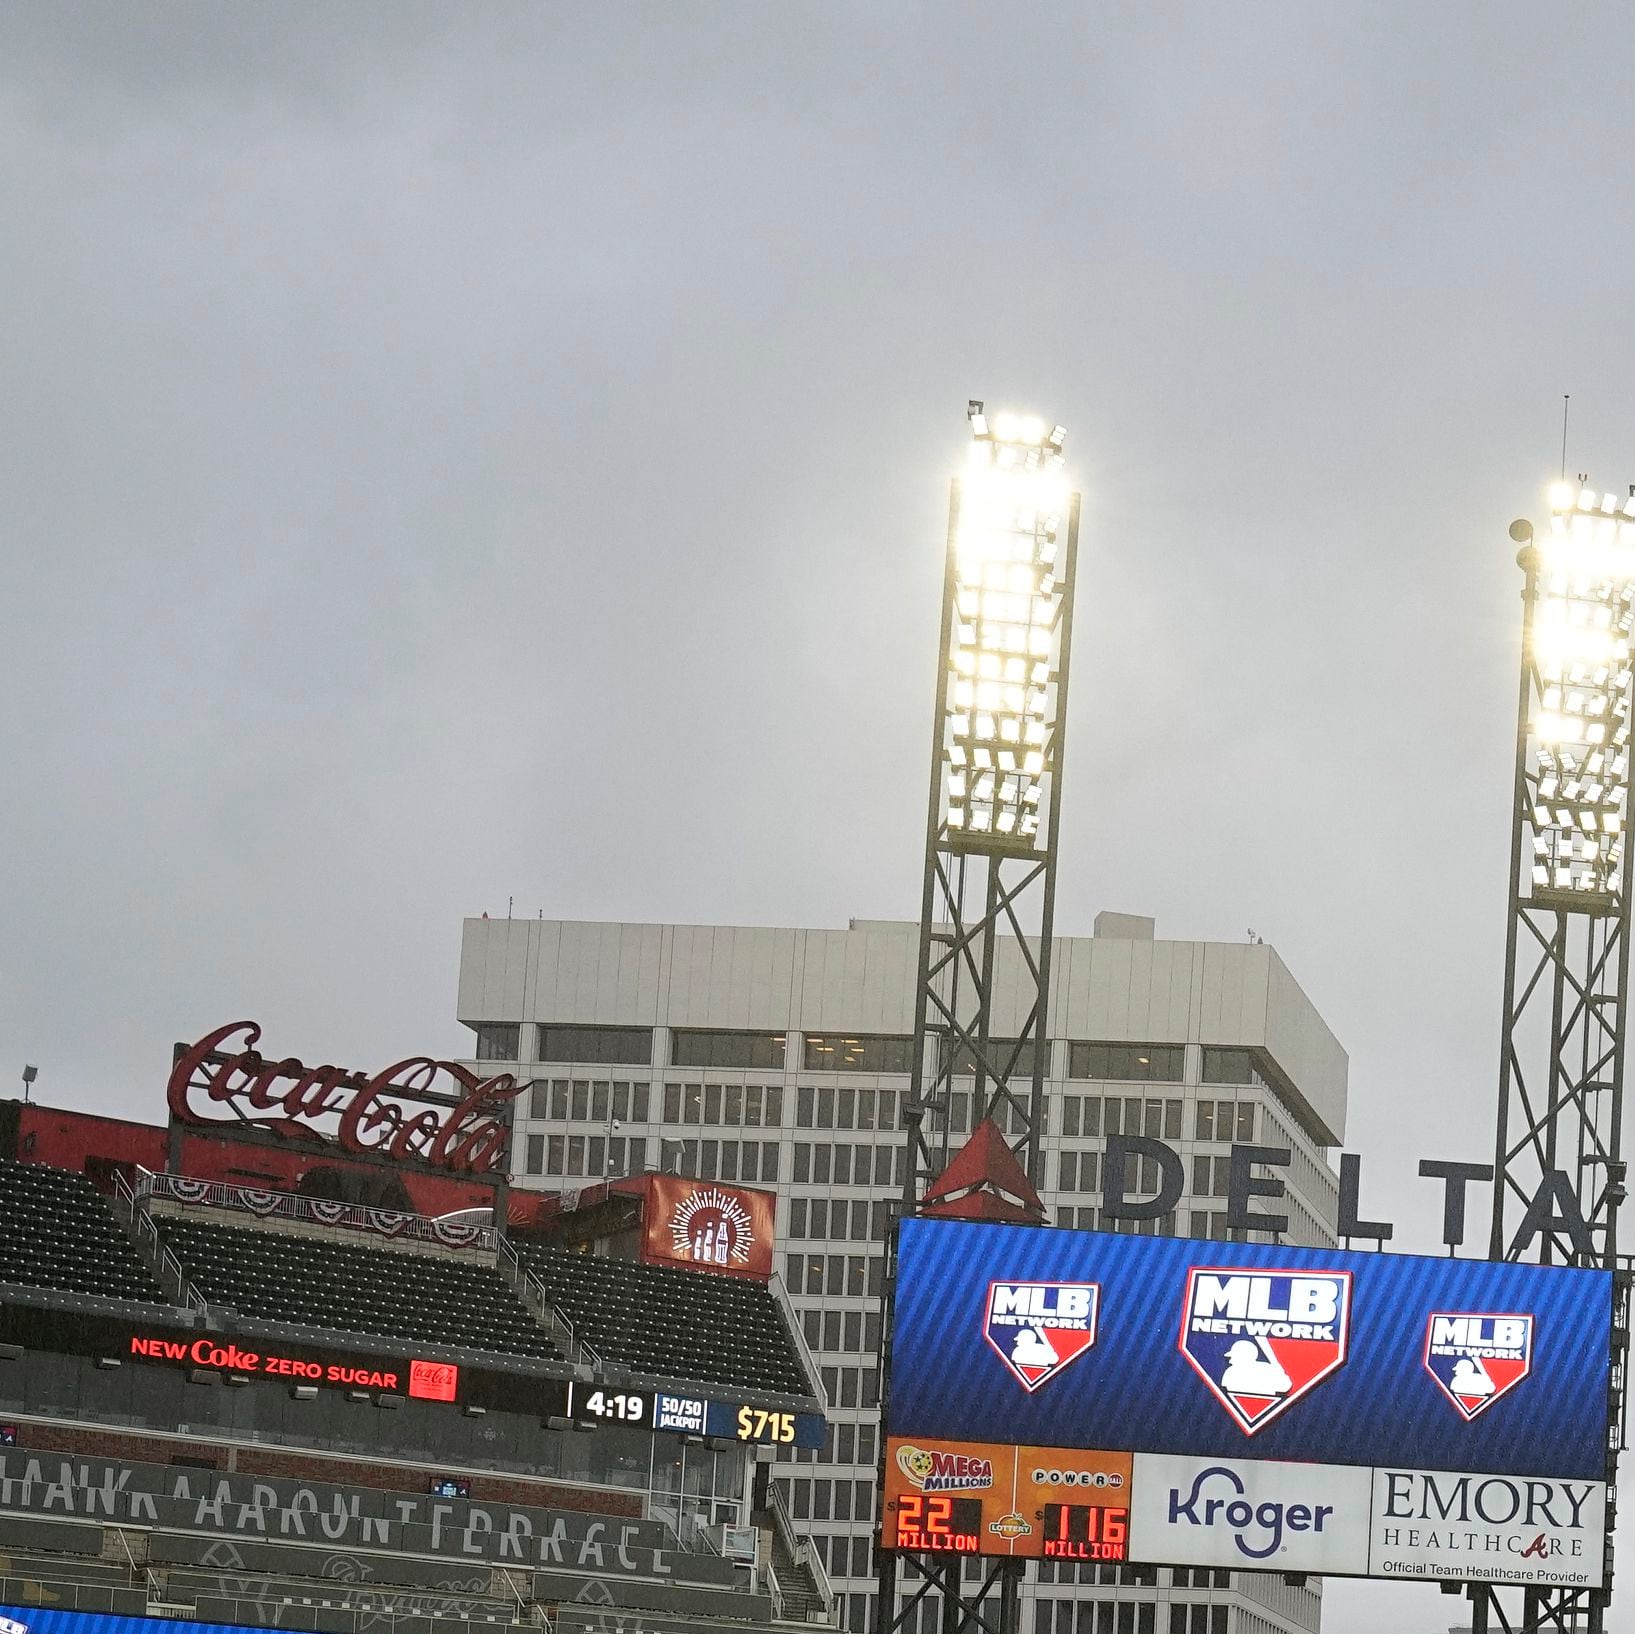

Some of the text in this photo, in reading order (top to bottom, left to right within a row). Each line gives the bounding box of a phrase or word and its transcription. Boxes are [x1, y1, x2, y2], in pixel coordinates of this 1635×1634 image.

[1101, 1134, 1597, 1256] DELTA
[992, 1285, 1091, 1319] MLB
[1193, 1275, 1338, 1326] MLB
[992, 1313, 1089, 1330] NETWORK
[1191, 1319, 1335, 1341] NETWORK
[1431, 1317, 1526, 1349] MLB
[131, 1338, 398, 1389] NEW Coke ZERO SUGAR
[1430, 1344, 1524, 1361] NETWORK
[586, 1391, 644, 1421] 4:19
[660, 1413, 702, 1430] JACKPOT
[661, 1397, 702, 1417] 50/50
[737, 1405, 796, 1443] $715
[931, 1452, 992, 1478] MEGA
[924, 1474, 993, 1492] MILLIONS
[897, 1495, 952, 1534] 22
[1168, 1466, 1334, 1559] Kroger
[1382, 1471, 1597, 1529] EMORY
[171, 1475, 390, 1544] AARON
[400, 1500, 673, 1575] TERRACE
[990, 1523, 1031, 1534] LOTTERY
[1058, 1505, 1129, 1544] 116
[897, 1531, 979, 1551] MILLION
[1045, 1540, 1124, 1560] MILLION
[1383, 1528, 1583, 1560] HEALTHCARE
[1383, 1560, 1590, 1584] Official Team Healthcare Provider
